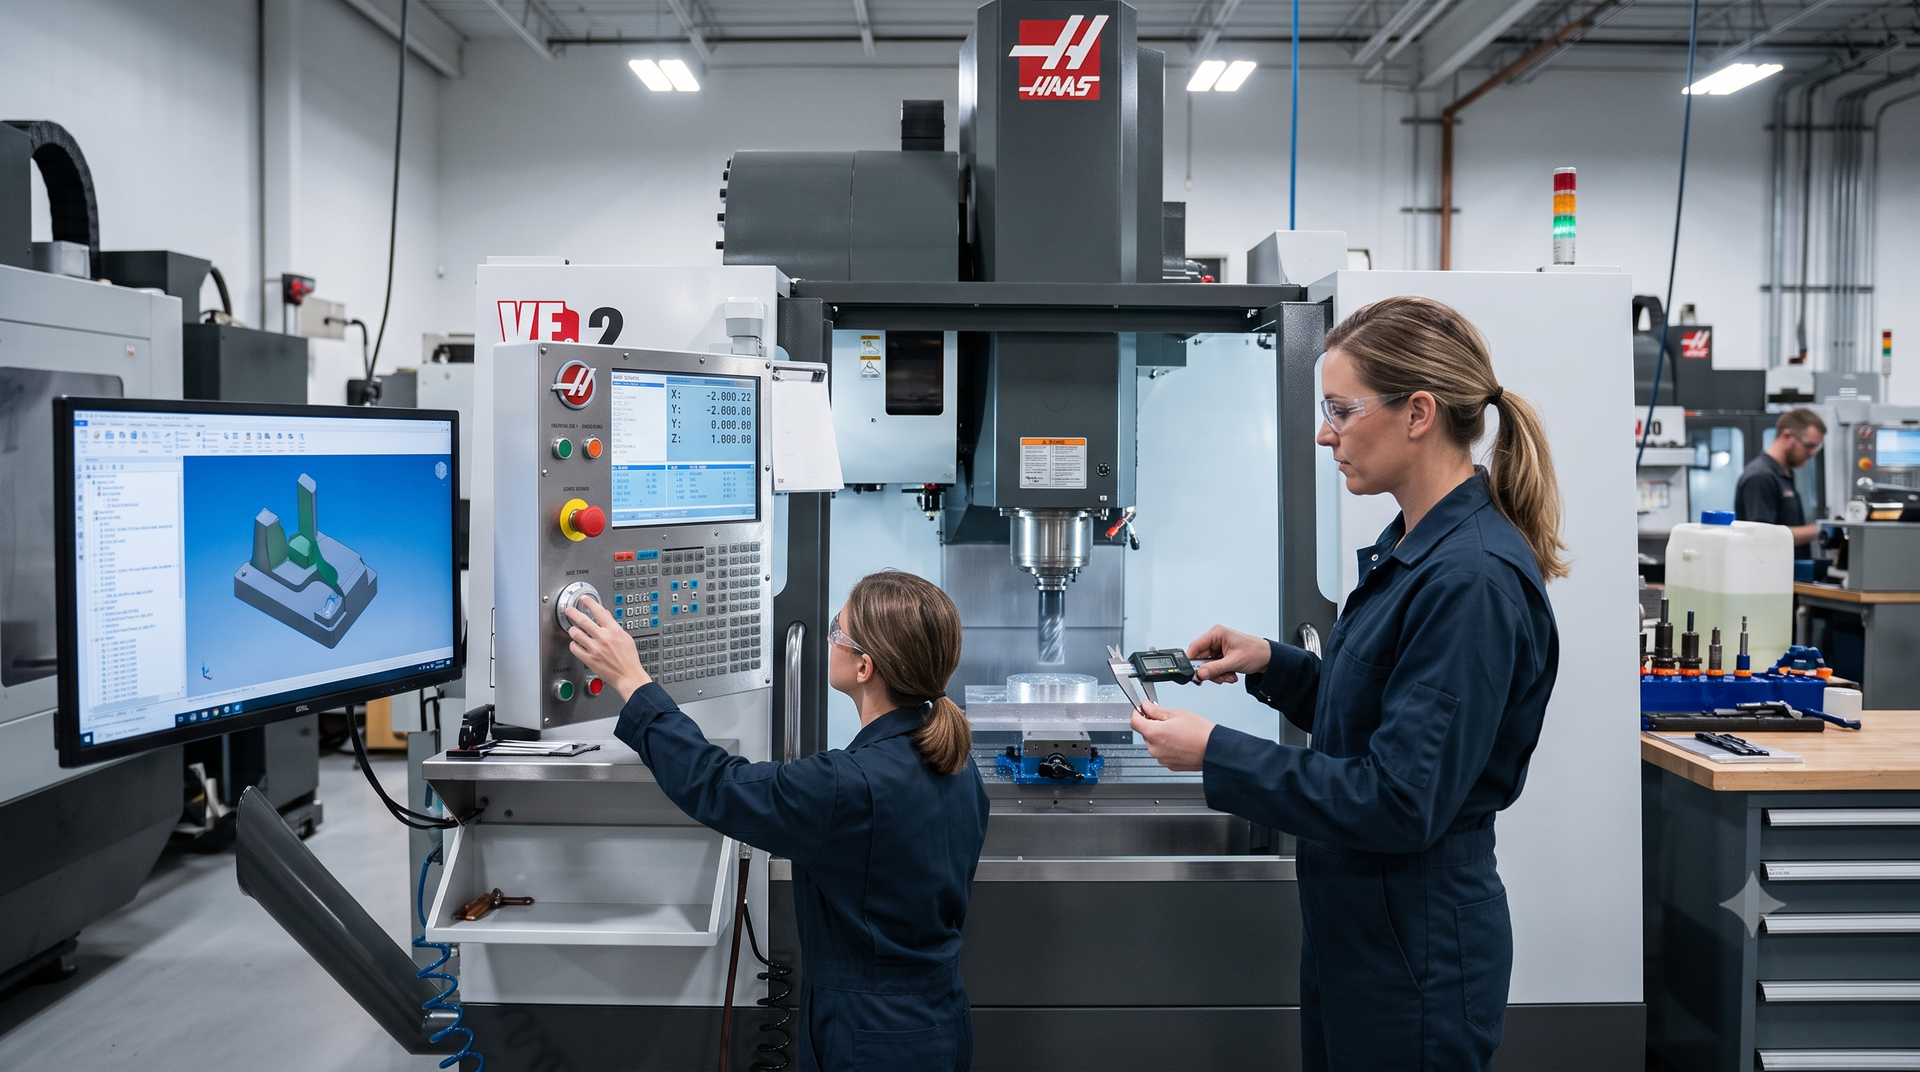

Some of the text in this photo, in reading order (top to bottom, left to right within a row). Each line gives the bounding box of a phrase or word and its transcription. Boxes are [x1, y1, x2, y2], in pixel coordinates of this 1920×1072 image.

[1018, 75, 1101, 97] HAAS
[671, 389, 681, 400] X:
[671, 404, 681, 415] Y:
[671, 418, 681, 429] Y:
[671, 433, 681, 444] Z:
